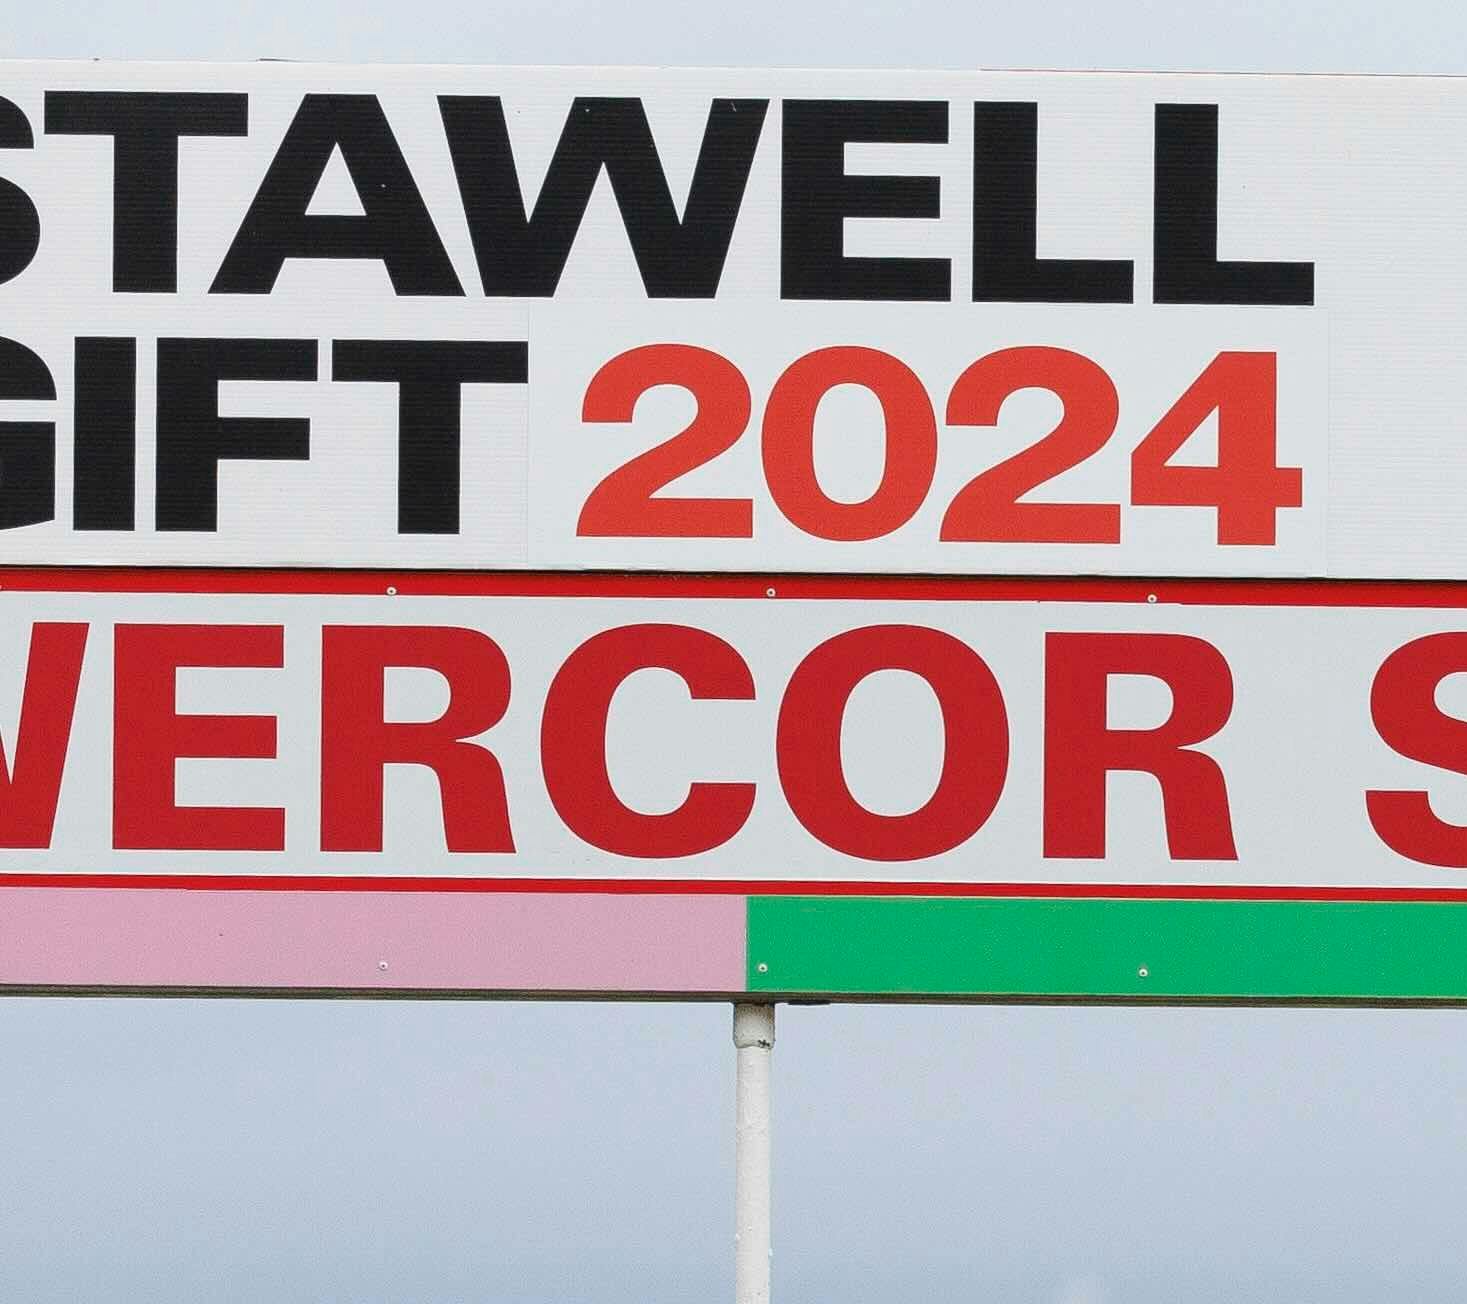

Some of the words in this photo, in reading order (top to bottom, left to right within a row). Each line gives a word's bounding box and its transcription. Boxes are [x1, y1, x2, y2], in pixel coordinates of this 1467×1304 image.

[0, 92, 1315, 306] TAWELL
[0, 338, 529, 535] IFT
[578, 345, 1303, 545] 2024
[0, 624, 1238, 862] ERCOR
